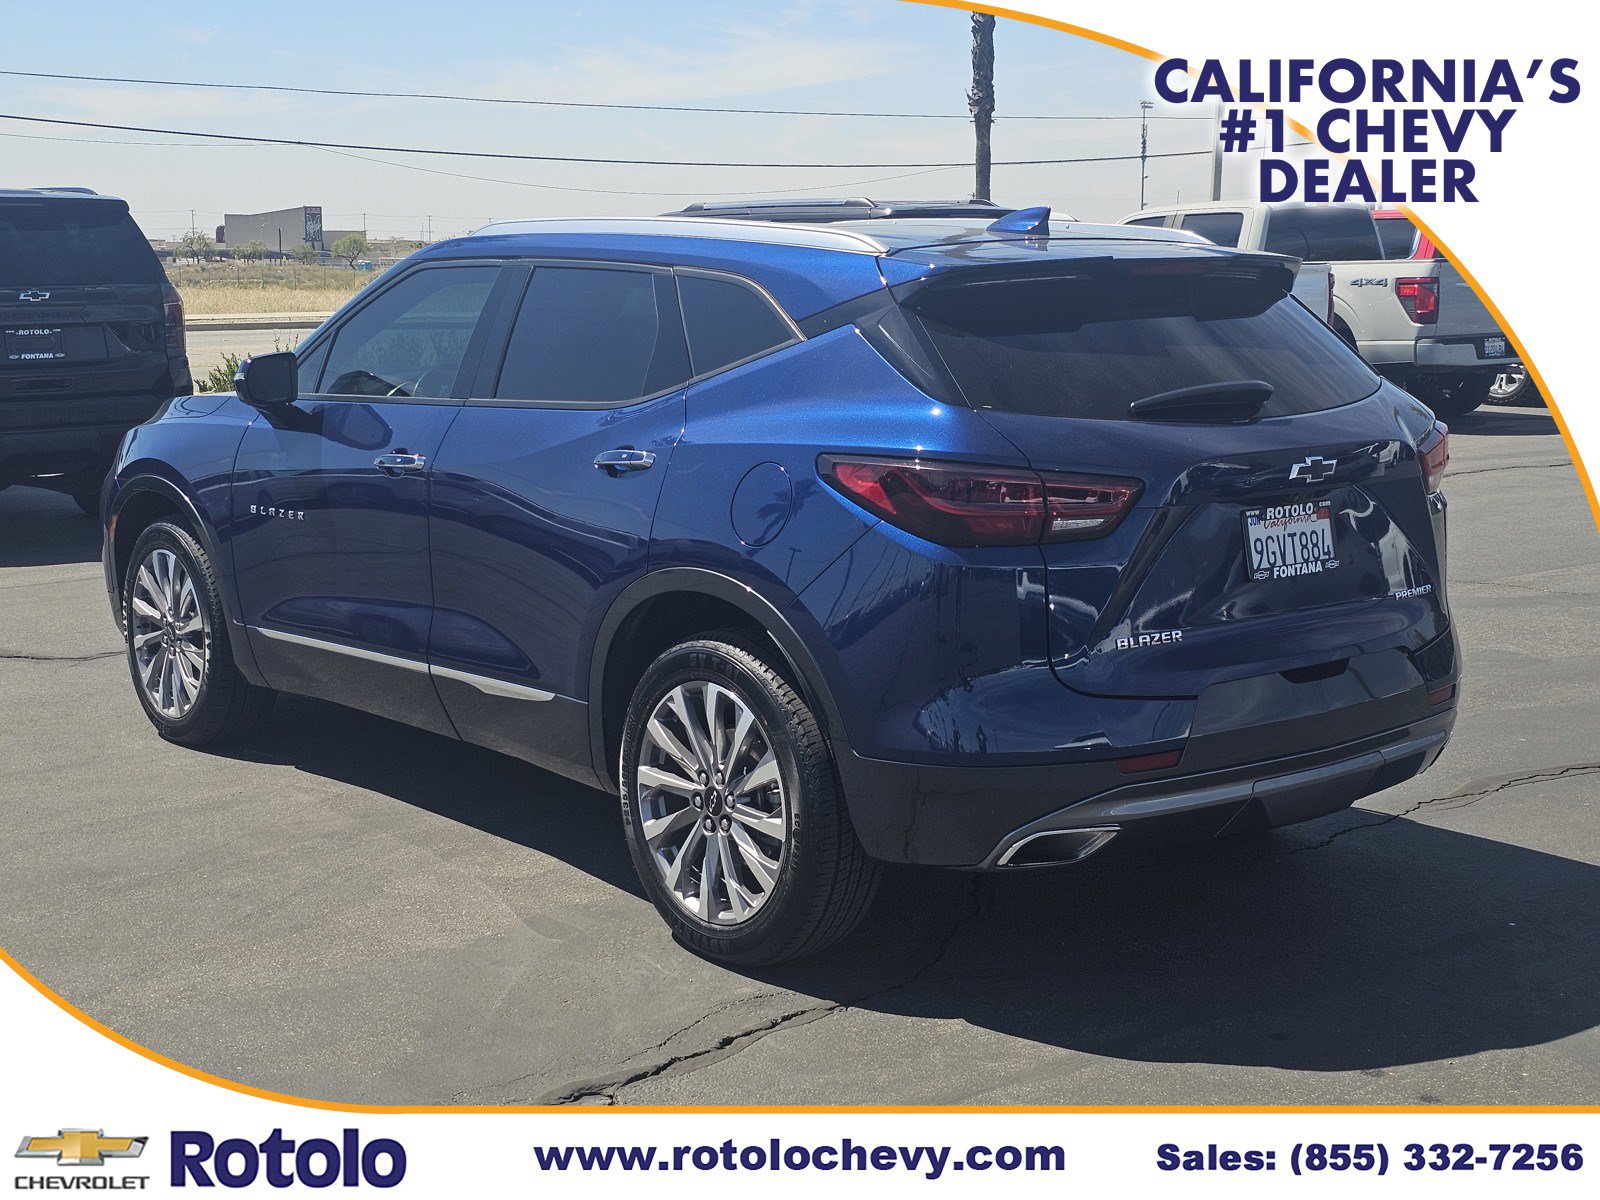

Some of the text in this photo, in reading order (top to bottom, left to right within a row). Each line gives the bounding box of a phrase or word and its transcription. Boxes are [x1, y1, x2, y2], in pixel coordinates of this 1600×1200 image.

[250, 504, 304, 520] BLAZER
[1266, 502, 1314, 520] ROTOLO
[1253, 529, 1331, 570] 9GVT884
[1273, 561, 1323, 579] FONTANA
[1395, 584, 1432, 600] PREMIER
[1116, 630, 1183, 651] BLAZER
